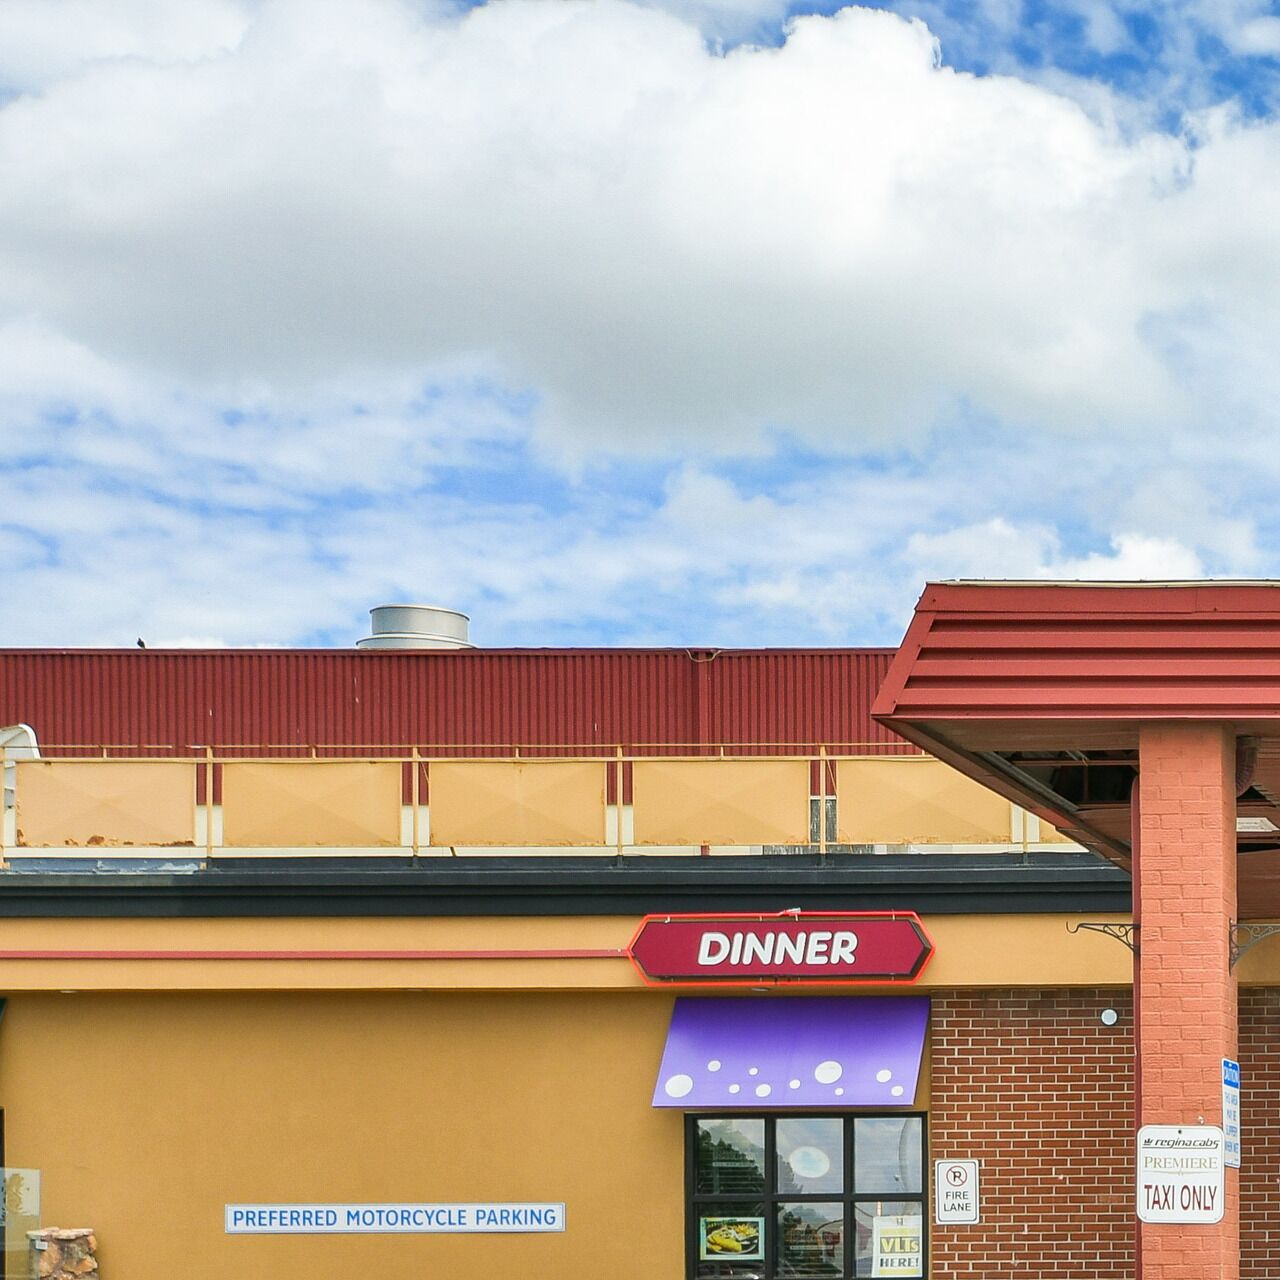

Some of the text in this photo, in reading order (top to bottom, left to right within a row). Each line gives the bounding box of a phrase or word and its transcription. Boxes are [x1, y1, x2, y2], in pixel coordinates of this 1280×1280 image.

[697, 931, 858, 965] DINNER
[1144, 1156, 1218, 1168] PREMIERE
[945, 1190, 969, 1200] FIRE
[1144, 1184, 1218, 1211] TAXI ONLY
[943, 1203, 972, 1212] LANE
[233, 1209, 557, 1226] PREFERRED MOTORCYCLE PARKING
[880, 1237, 919, 1254] VLTs
[880, 1257, 919, 1267] HERE!
